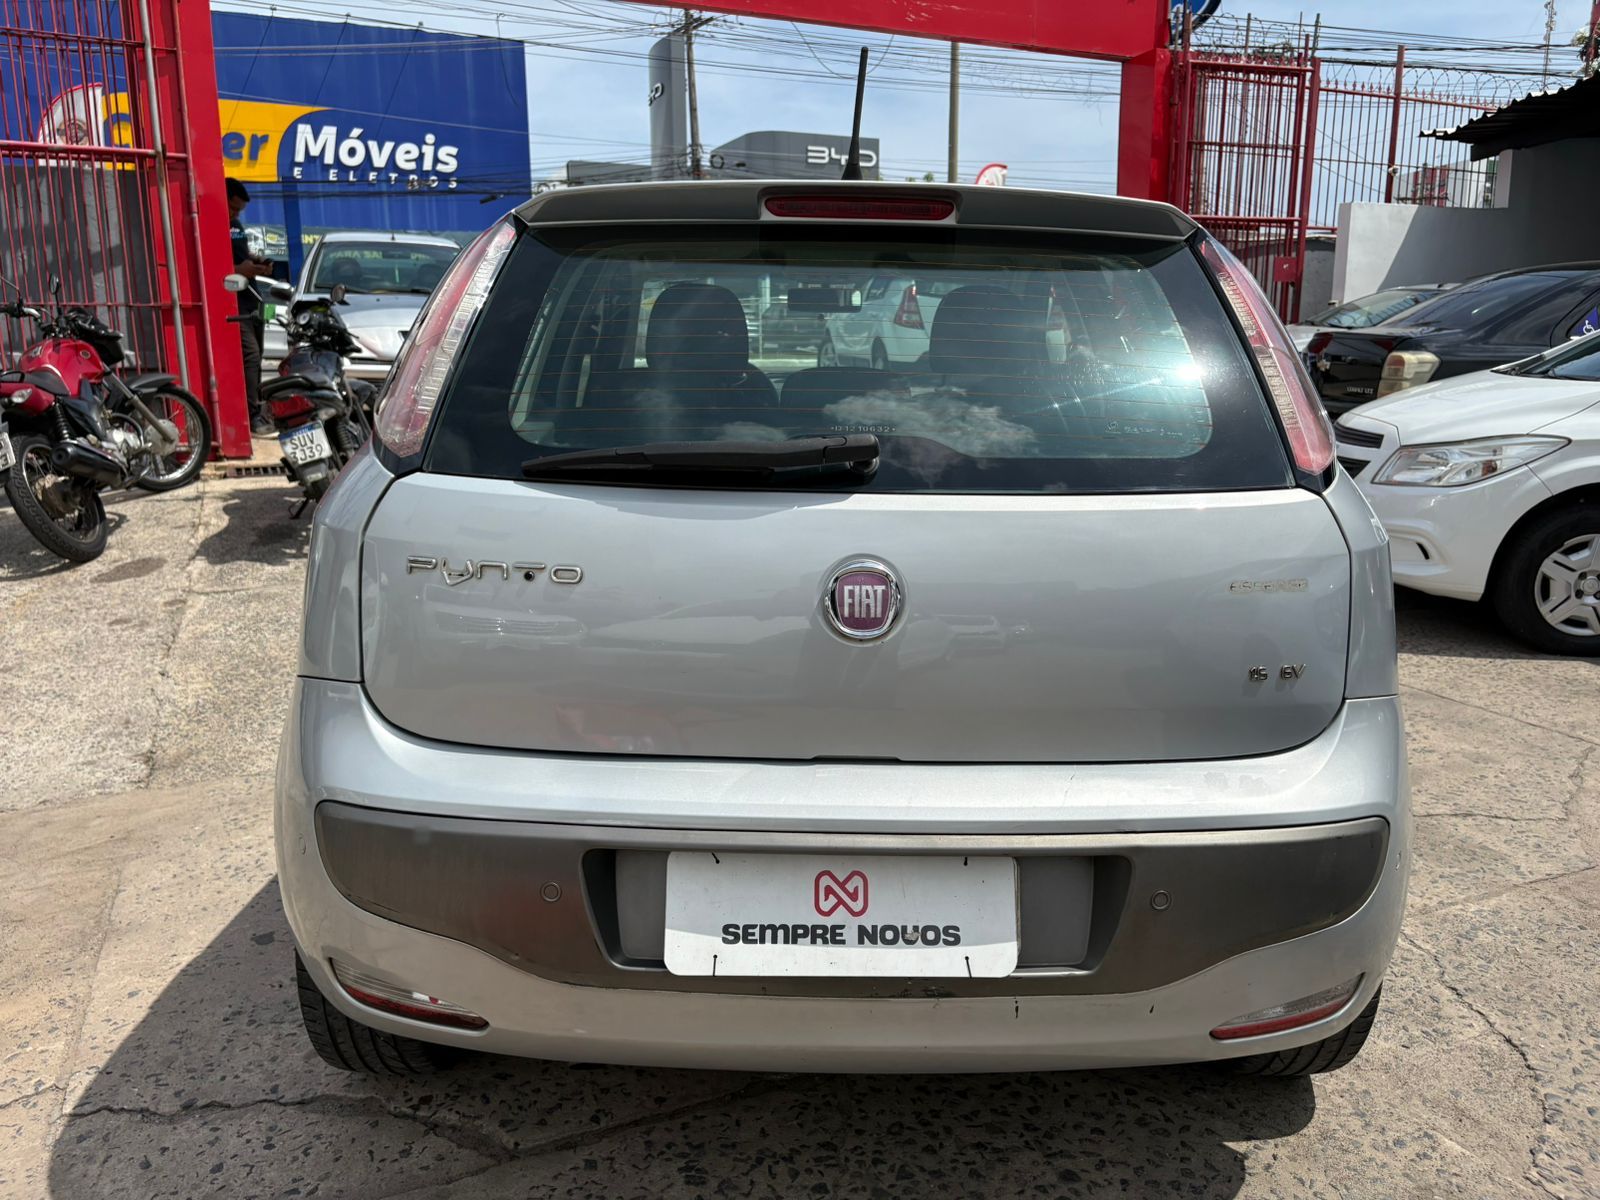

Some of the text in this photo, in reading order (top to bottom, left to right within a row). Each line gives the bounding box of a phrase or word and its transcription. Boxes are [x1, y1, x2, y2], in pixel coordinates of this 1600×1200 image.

[294, 123, 459, 173] Móveis
[807, 145, 877, 167] BYD
[293, 167, 458, 189] E ELETROS
[290, 432, 315, 450] SUV
[407, 555, 583, 586] PUNTO
[843, 584, 886, 618] FIAT
[721, 924, 846, 945] SEMPRE
